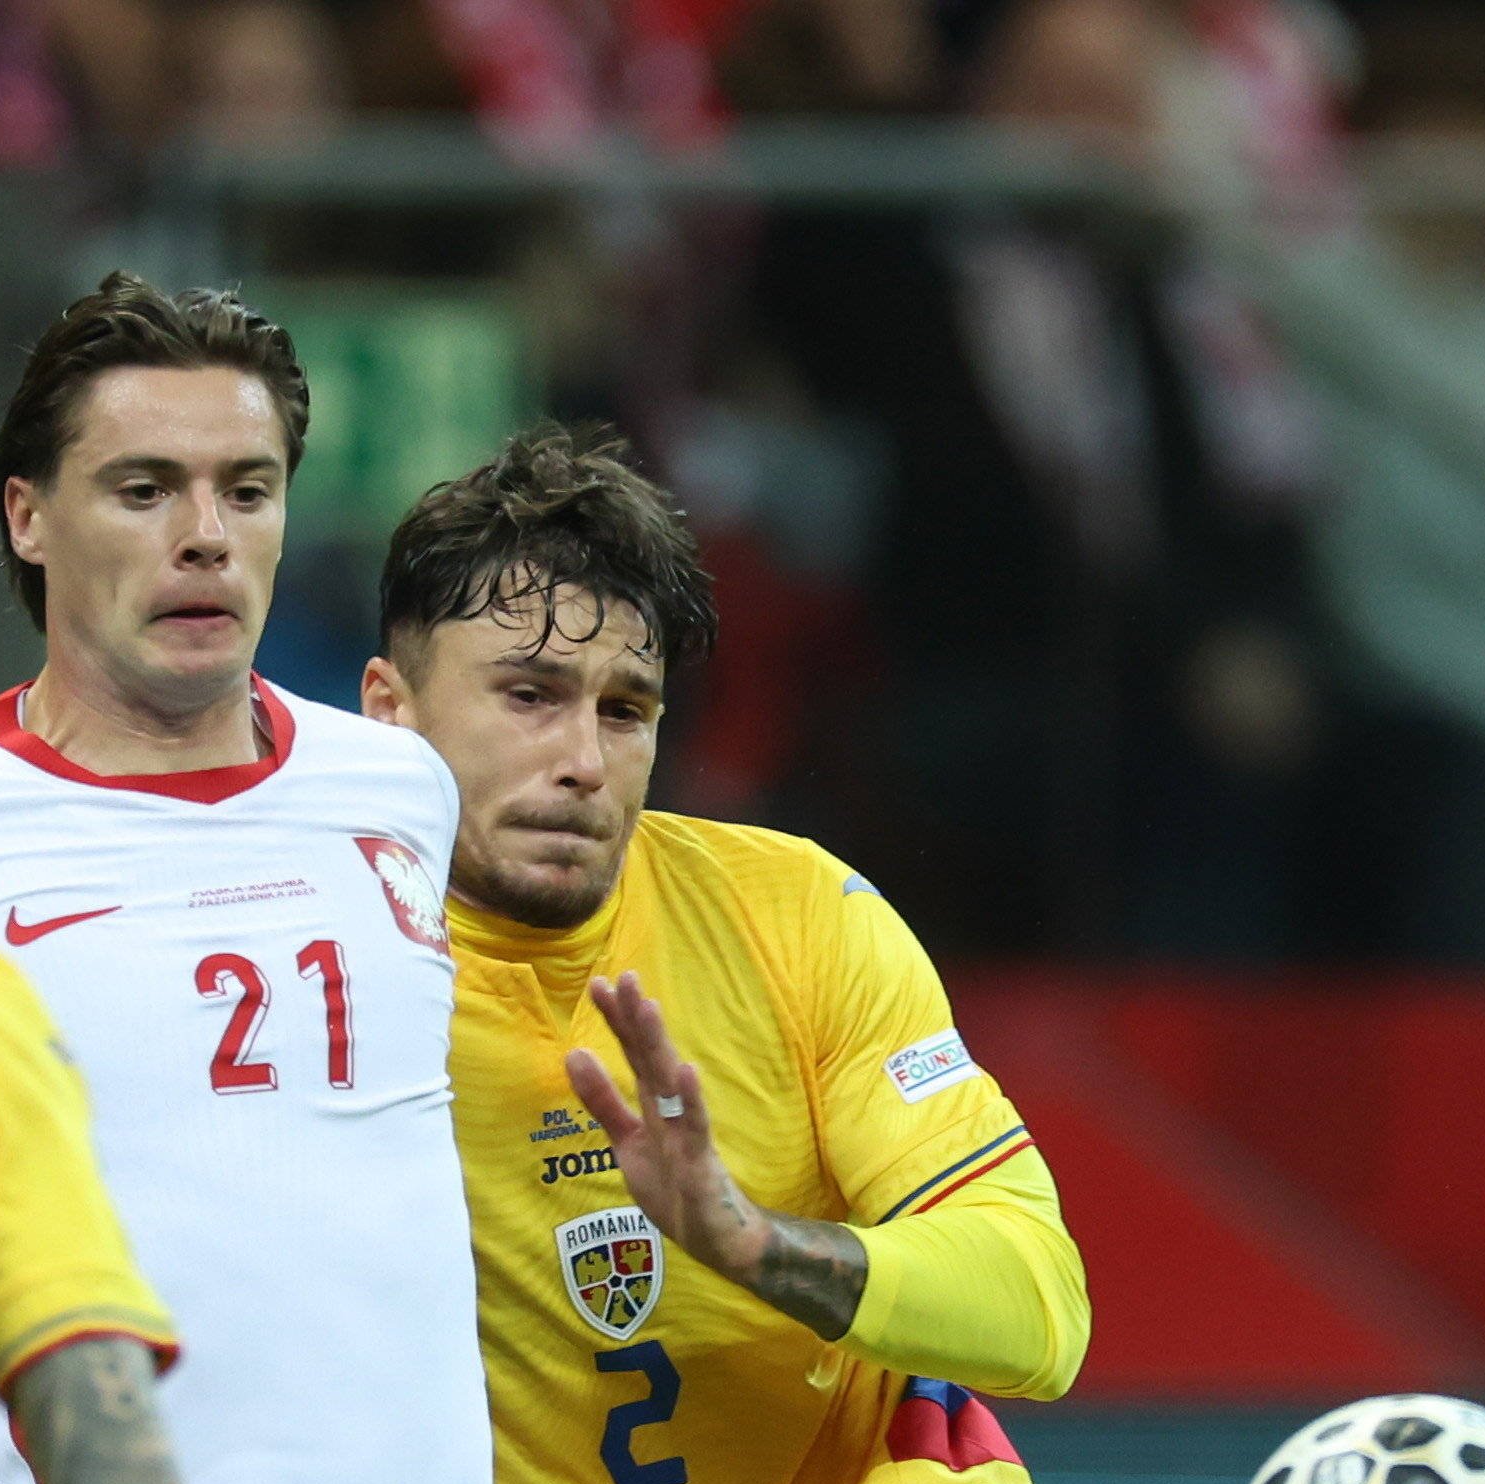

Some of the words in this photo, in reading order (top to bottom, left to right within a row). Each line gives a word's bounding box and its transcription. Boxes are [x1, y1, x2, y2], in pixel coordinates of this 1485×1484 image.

[194, 940, 355, 1095] 21
[542, 1108, 573, 1126] POL
[566, 1213, 649, 1248] ROMÂNIA
